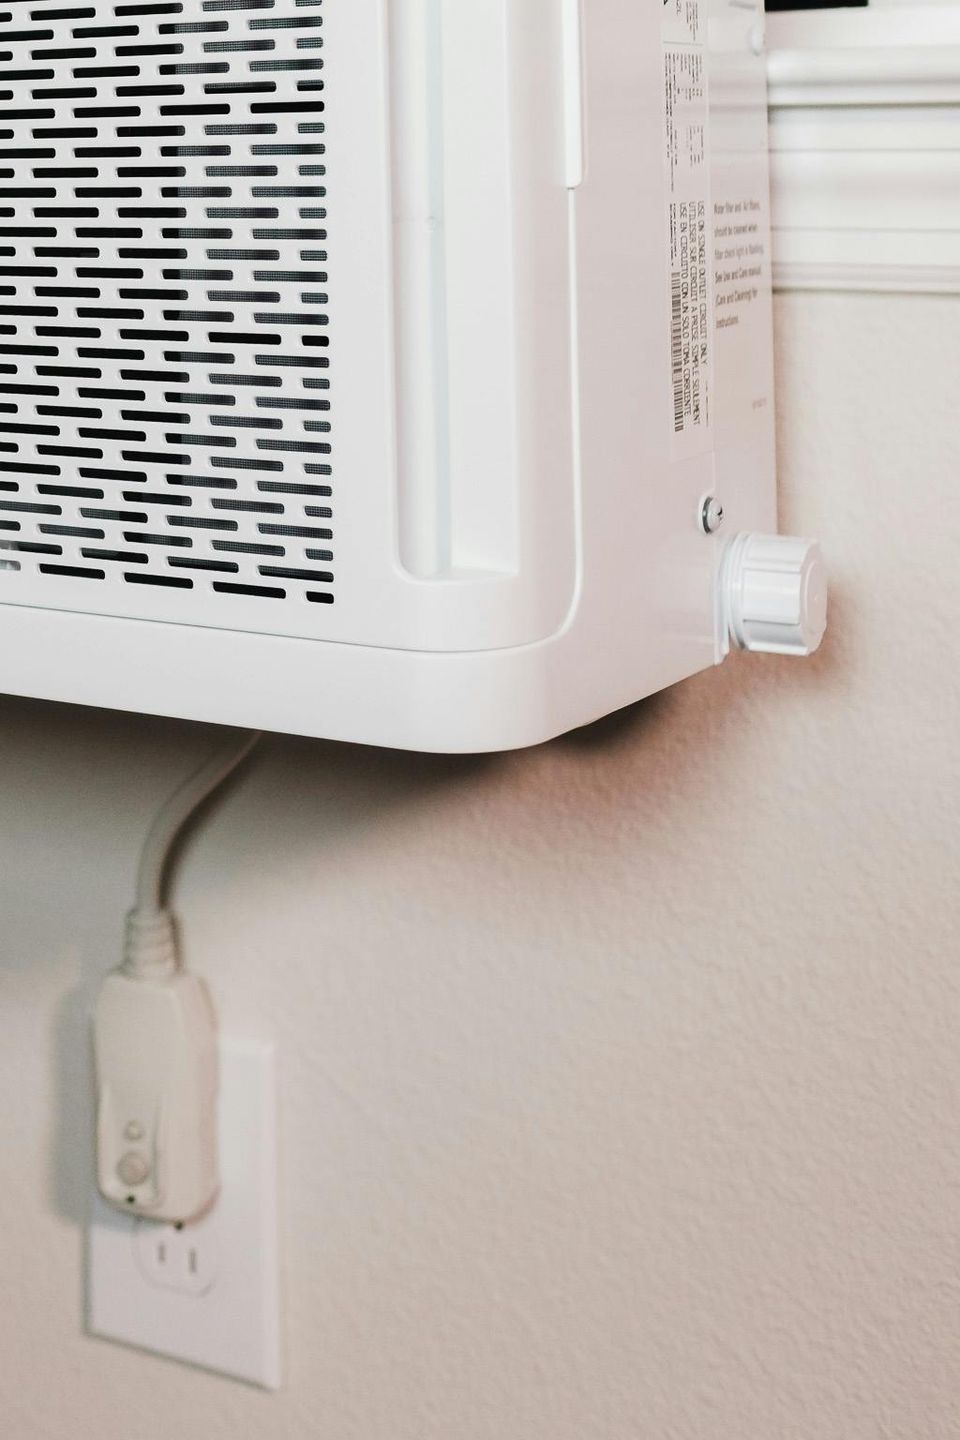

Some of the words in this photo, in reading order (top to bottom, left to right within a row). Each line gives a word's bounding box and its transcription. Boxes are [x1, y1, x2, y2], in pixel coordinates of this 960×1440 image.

[679, 202, 688, 218] USE
[697, 201, 705, 217] USE
[680, 222, 688, 232] EN
[688, 201, 697, 243] UTILISER
[698, 220, 705, 232] ON
[680, 235, 689, 279] CIRCUITO
[689, 247, 697, 263] SUR
[698, 234, 706, 265] SINGLE
[681, 281, 689, 299] CON
[690, 266, 698, 301] CIRCUIT
[682, 302, 689, 314] UN
[682, 315, 690, 339] SOLO
[691, 315, 699, 342] PRISE
[682, 342, 690, 365] TOMA
[691, 345, 699, 376] SIMPLE
[683, 368, 692, 416] CORRIENTE
[692, 379, 700, 425] SEULEMENT
